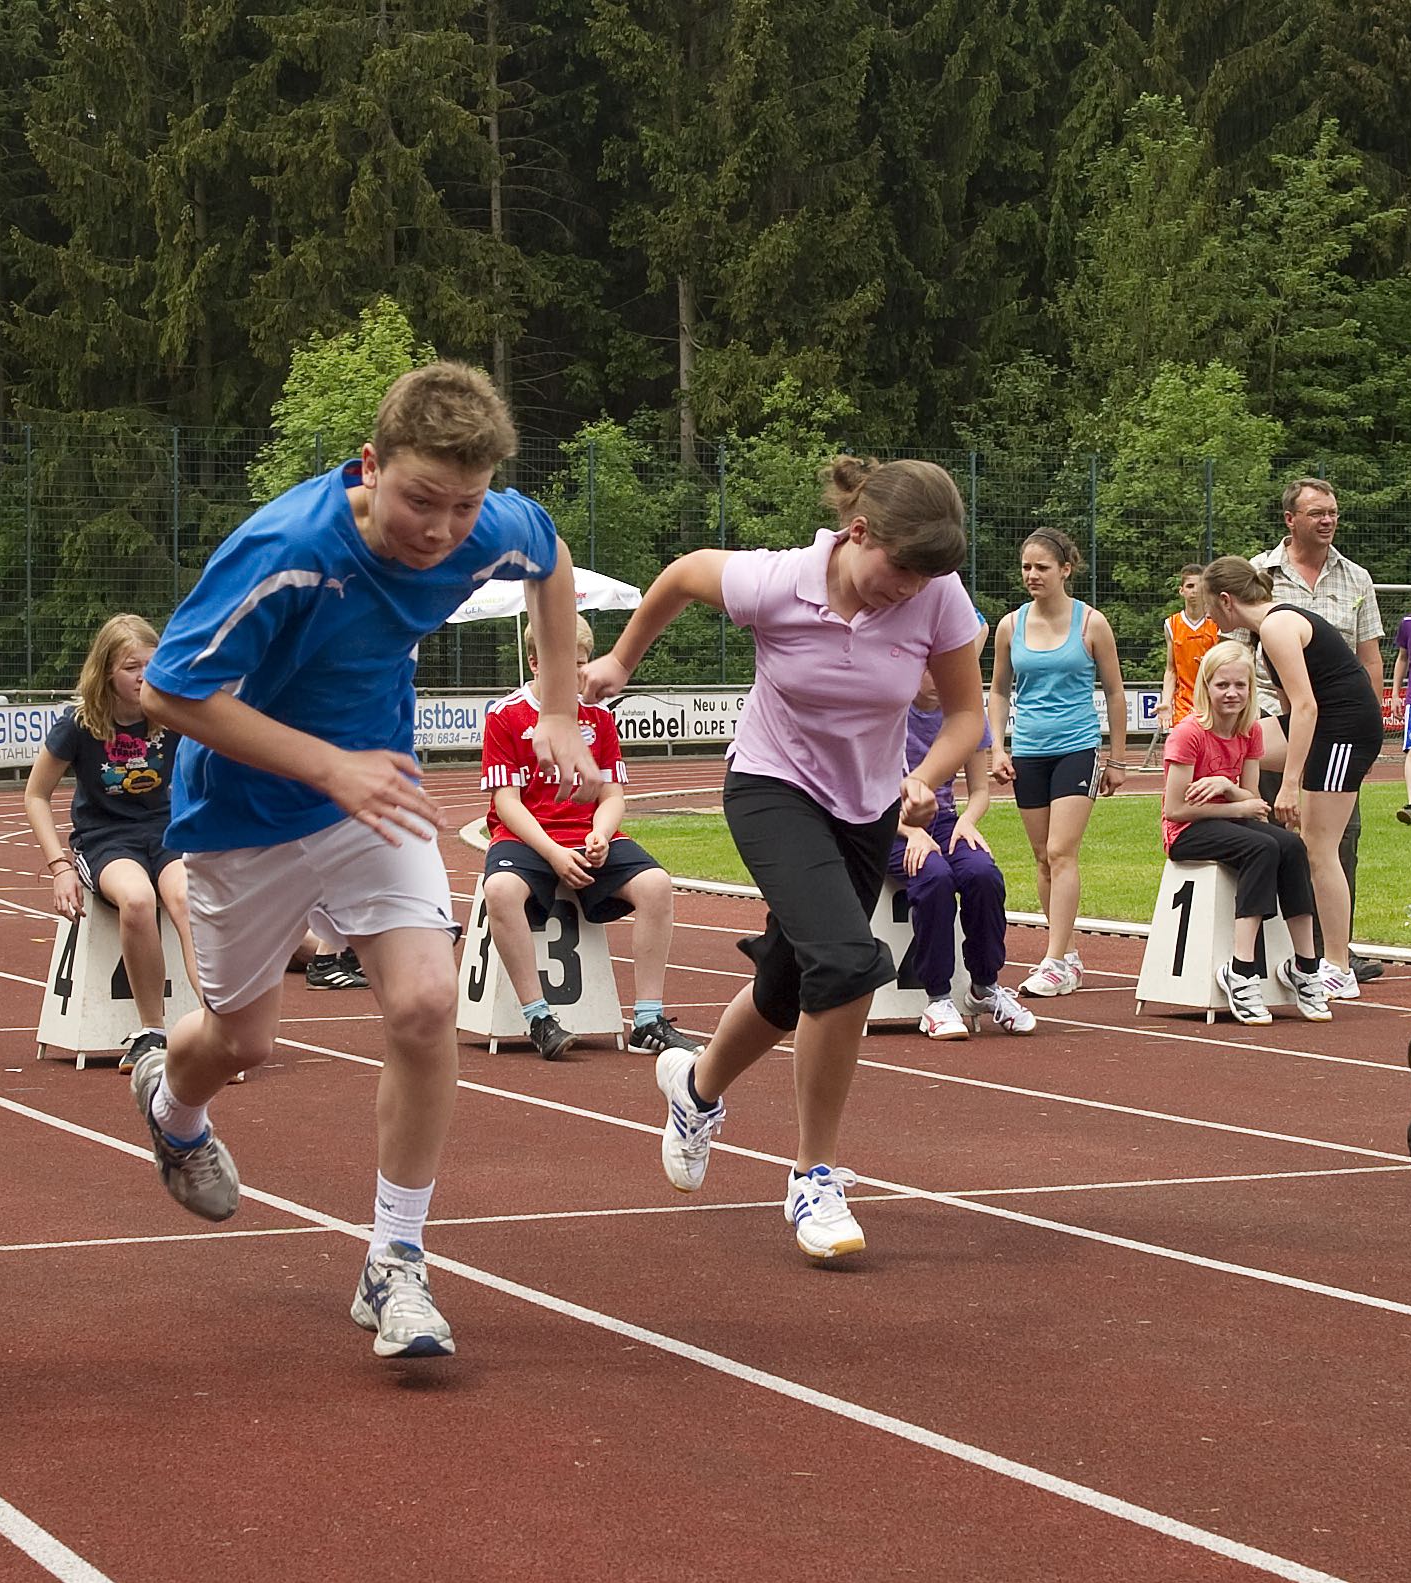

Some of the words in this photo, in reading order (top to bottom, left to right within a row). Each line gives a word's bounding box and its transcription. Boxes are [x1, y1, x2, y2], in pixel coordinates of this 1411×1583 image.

[693, 698, 716, 712] Neu
[736, 697, 745, 711] G
[694, 720, 725, 735] OLPE
[470, 731, 483, 744] FA
[525, 898, 583, 1006] 3
[1171, 880, 1195, 977] 1
[53, 909, 82, 1017] 4
